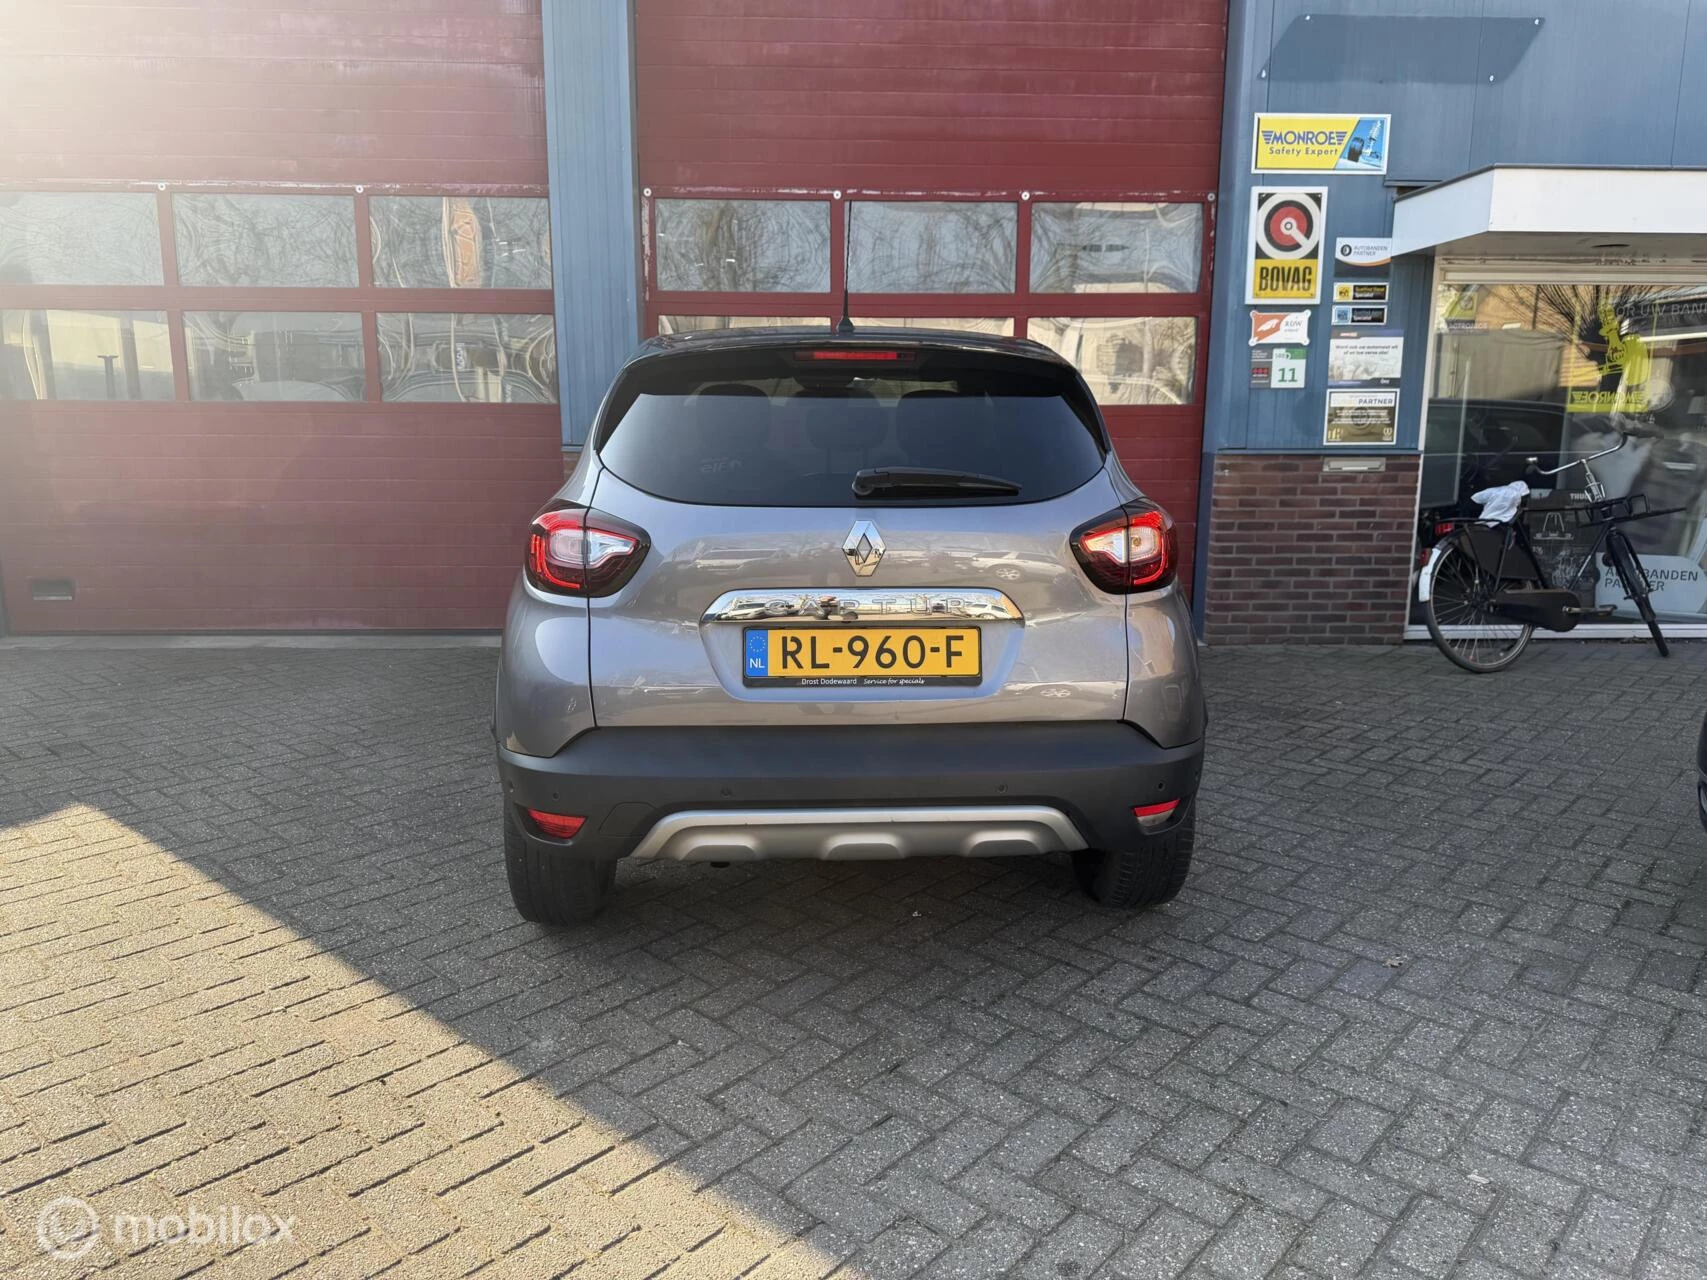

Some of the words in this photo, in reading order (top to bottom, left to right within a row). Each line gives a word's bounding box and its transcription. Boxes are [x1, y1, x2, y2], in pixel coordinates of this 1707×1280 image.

[1271, 131, 1336, 145] MONROE
[1269, 146, 1301, 156] Safety
[1305, 147, 1338, 157] Expert
[1259, 265, 1312, 291] BOVAG
[1277, 367, 1298, 383] 11
[1604, 566, 1699, 582] ABANDEN
[764, 598, 968, 616] CAPTUR
[750, 658, 765, 669] NL
[782, 635, 964, 669] RL-960-F
[801, 677, 820, 685] Drost
[820, 677, 857, 685] Dodewaard
[887, 677, 898, 687] for
[899, 677, 926, 687] specials
